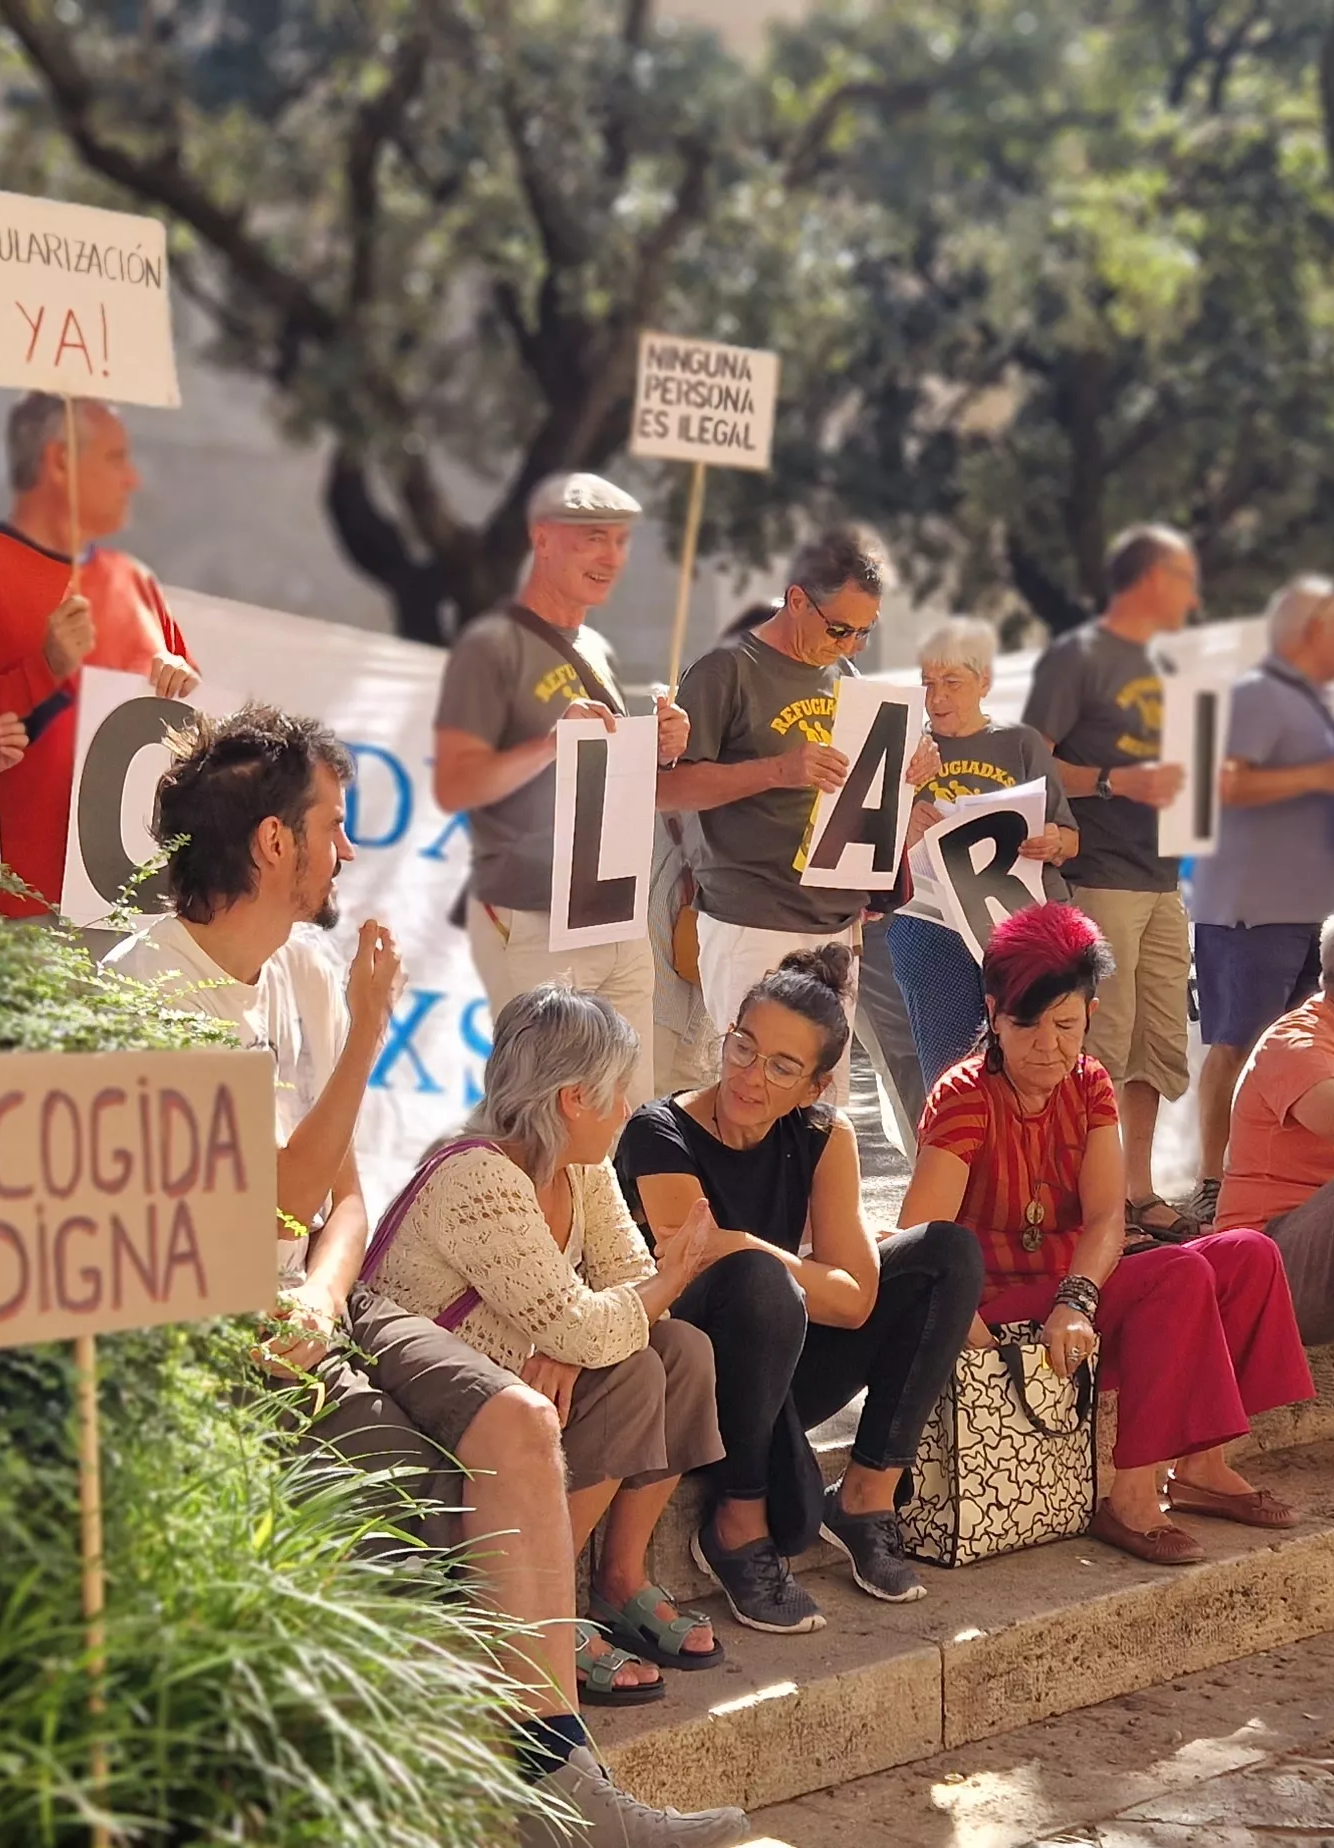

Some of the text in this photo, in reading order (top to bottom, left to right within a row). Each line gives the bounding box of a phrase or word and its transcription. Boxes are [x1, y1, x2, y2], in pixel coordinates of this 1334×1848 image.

[14, 300, 110, 378] YA!
[646, 344, 753, 382] NINGUNA
[639, 408, 757, 451] ES ILEGAL
[644, 373, 755, 415] PERSONA
[809, 700, 909, 873] A
[567, 738, 638, 930] L
[938, 810, 1043, 950] R
